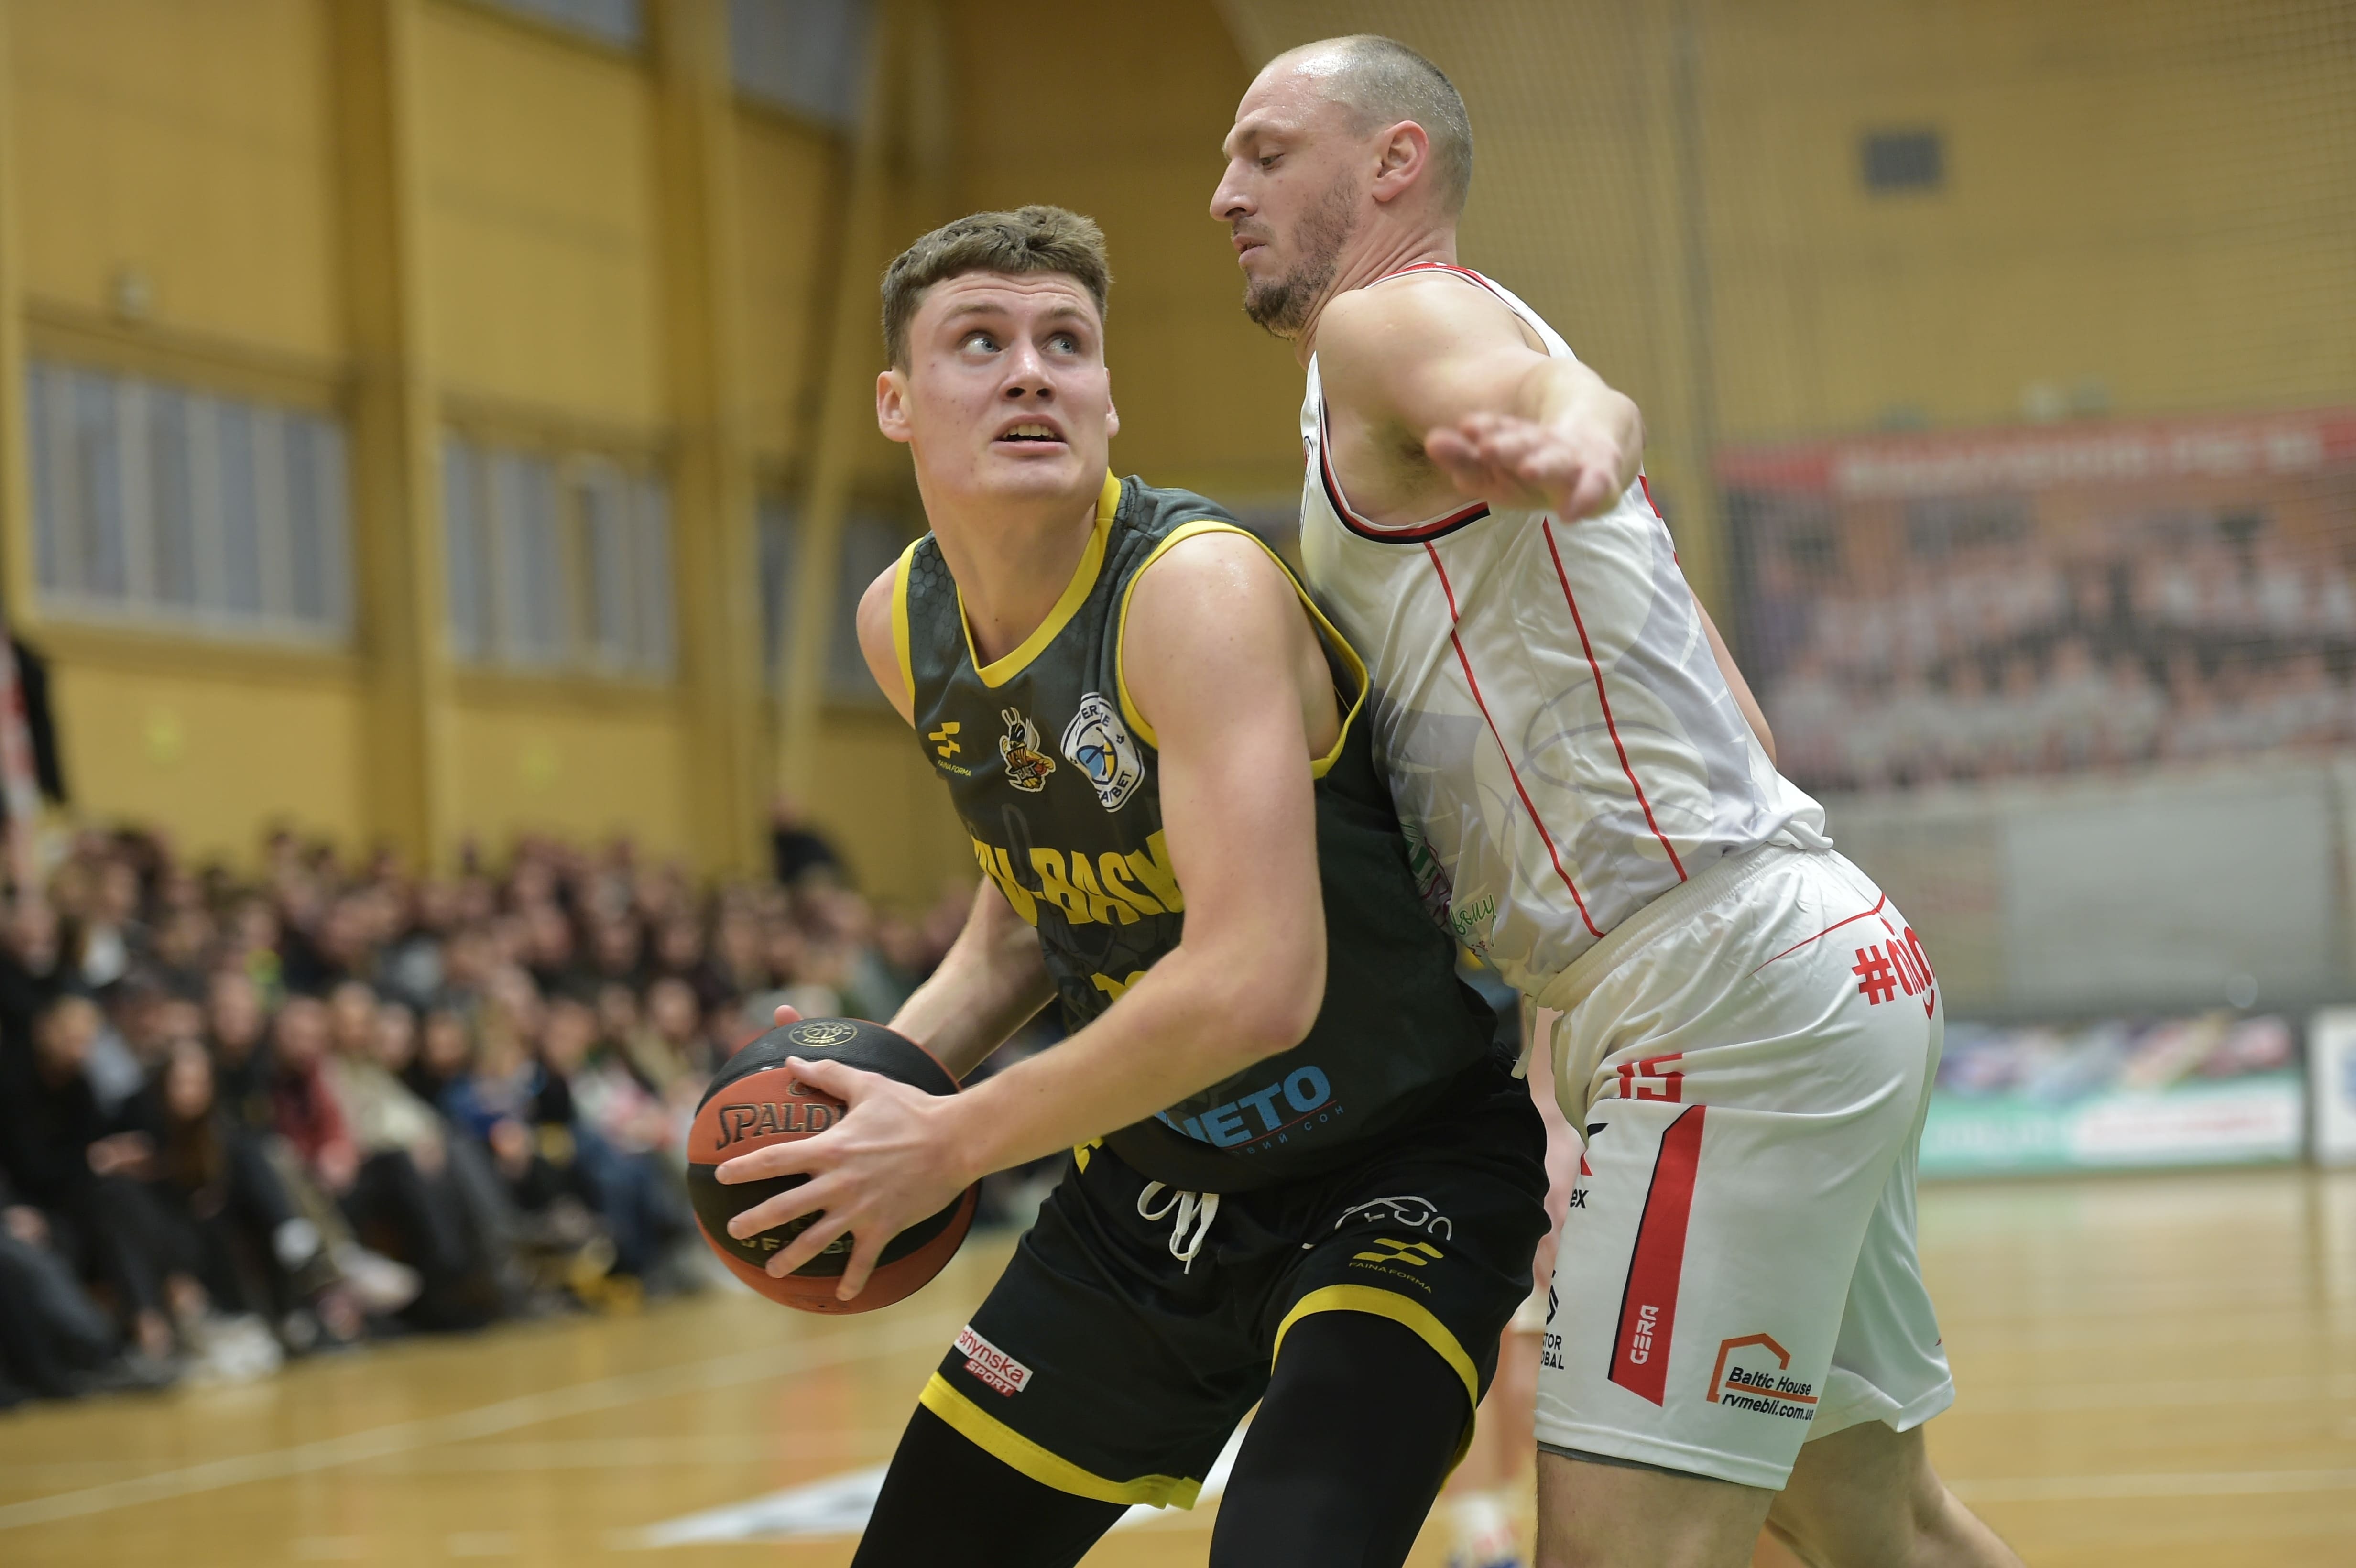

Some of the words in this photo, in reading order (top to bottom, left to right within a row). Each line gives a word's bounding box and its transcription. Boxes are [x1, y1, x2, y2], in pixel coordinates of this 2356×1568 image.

[951, 765, 971, 777] FORMA
[1617, 1053, 1686, 1103] 15
[1349, 1262, 1387, 1273] FAINA
[1389, 1269, 1432, 1293] FORMA
[966, 1361, 1014, 1394] SPORT
[1728, 1366, 1774, 1389] Baltic
[1776, 1376, 1811, 1396] House
[1722, 1393, 1814, 1421] rvmebli.com.ua
